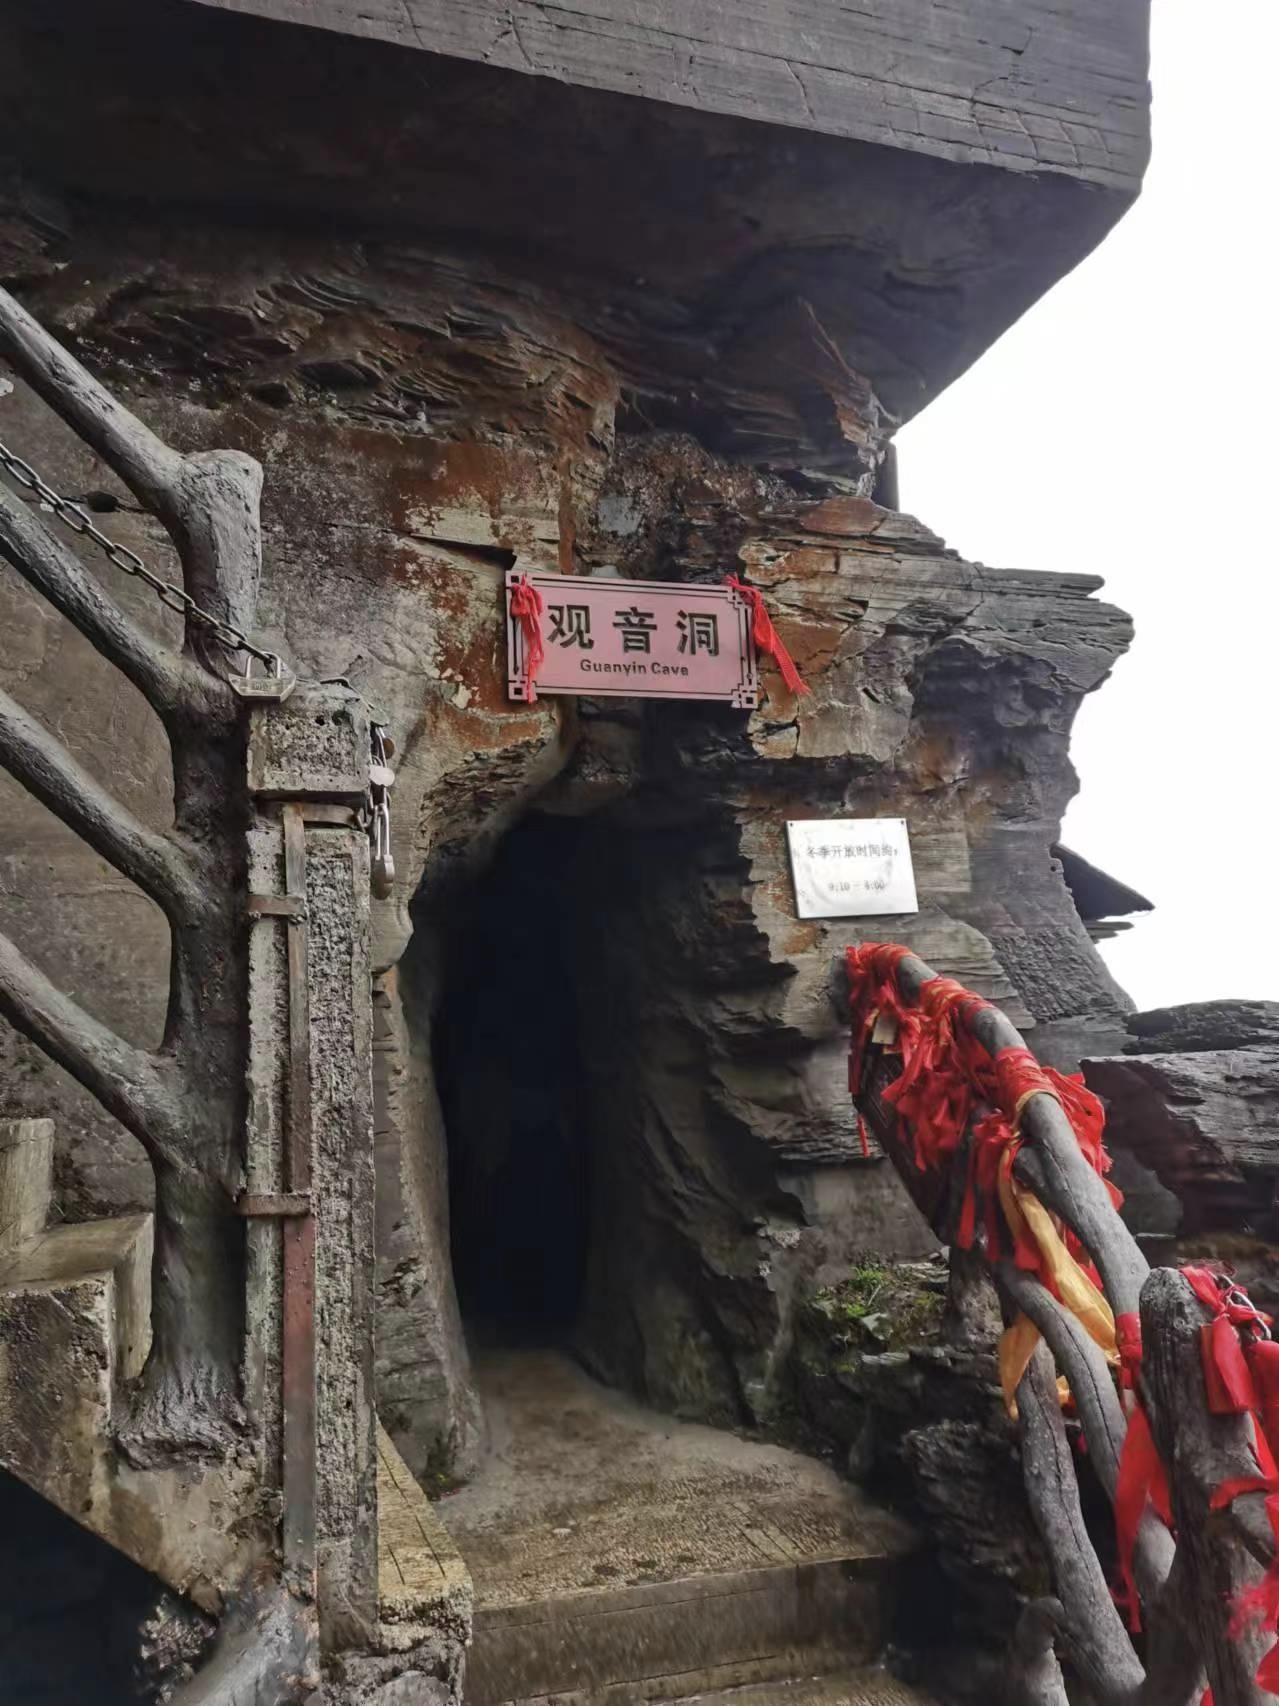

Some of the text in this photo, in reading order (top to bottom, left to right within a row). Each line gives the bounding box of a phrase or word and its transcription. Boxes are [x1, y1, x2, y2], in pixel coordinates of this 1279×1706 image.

[547, 603, 720, 657] 观音洞
[580, 659, 689, 678] Guanyin Cave
